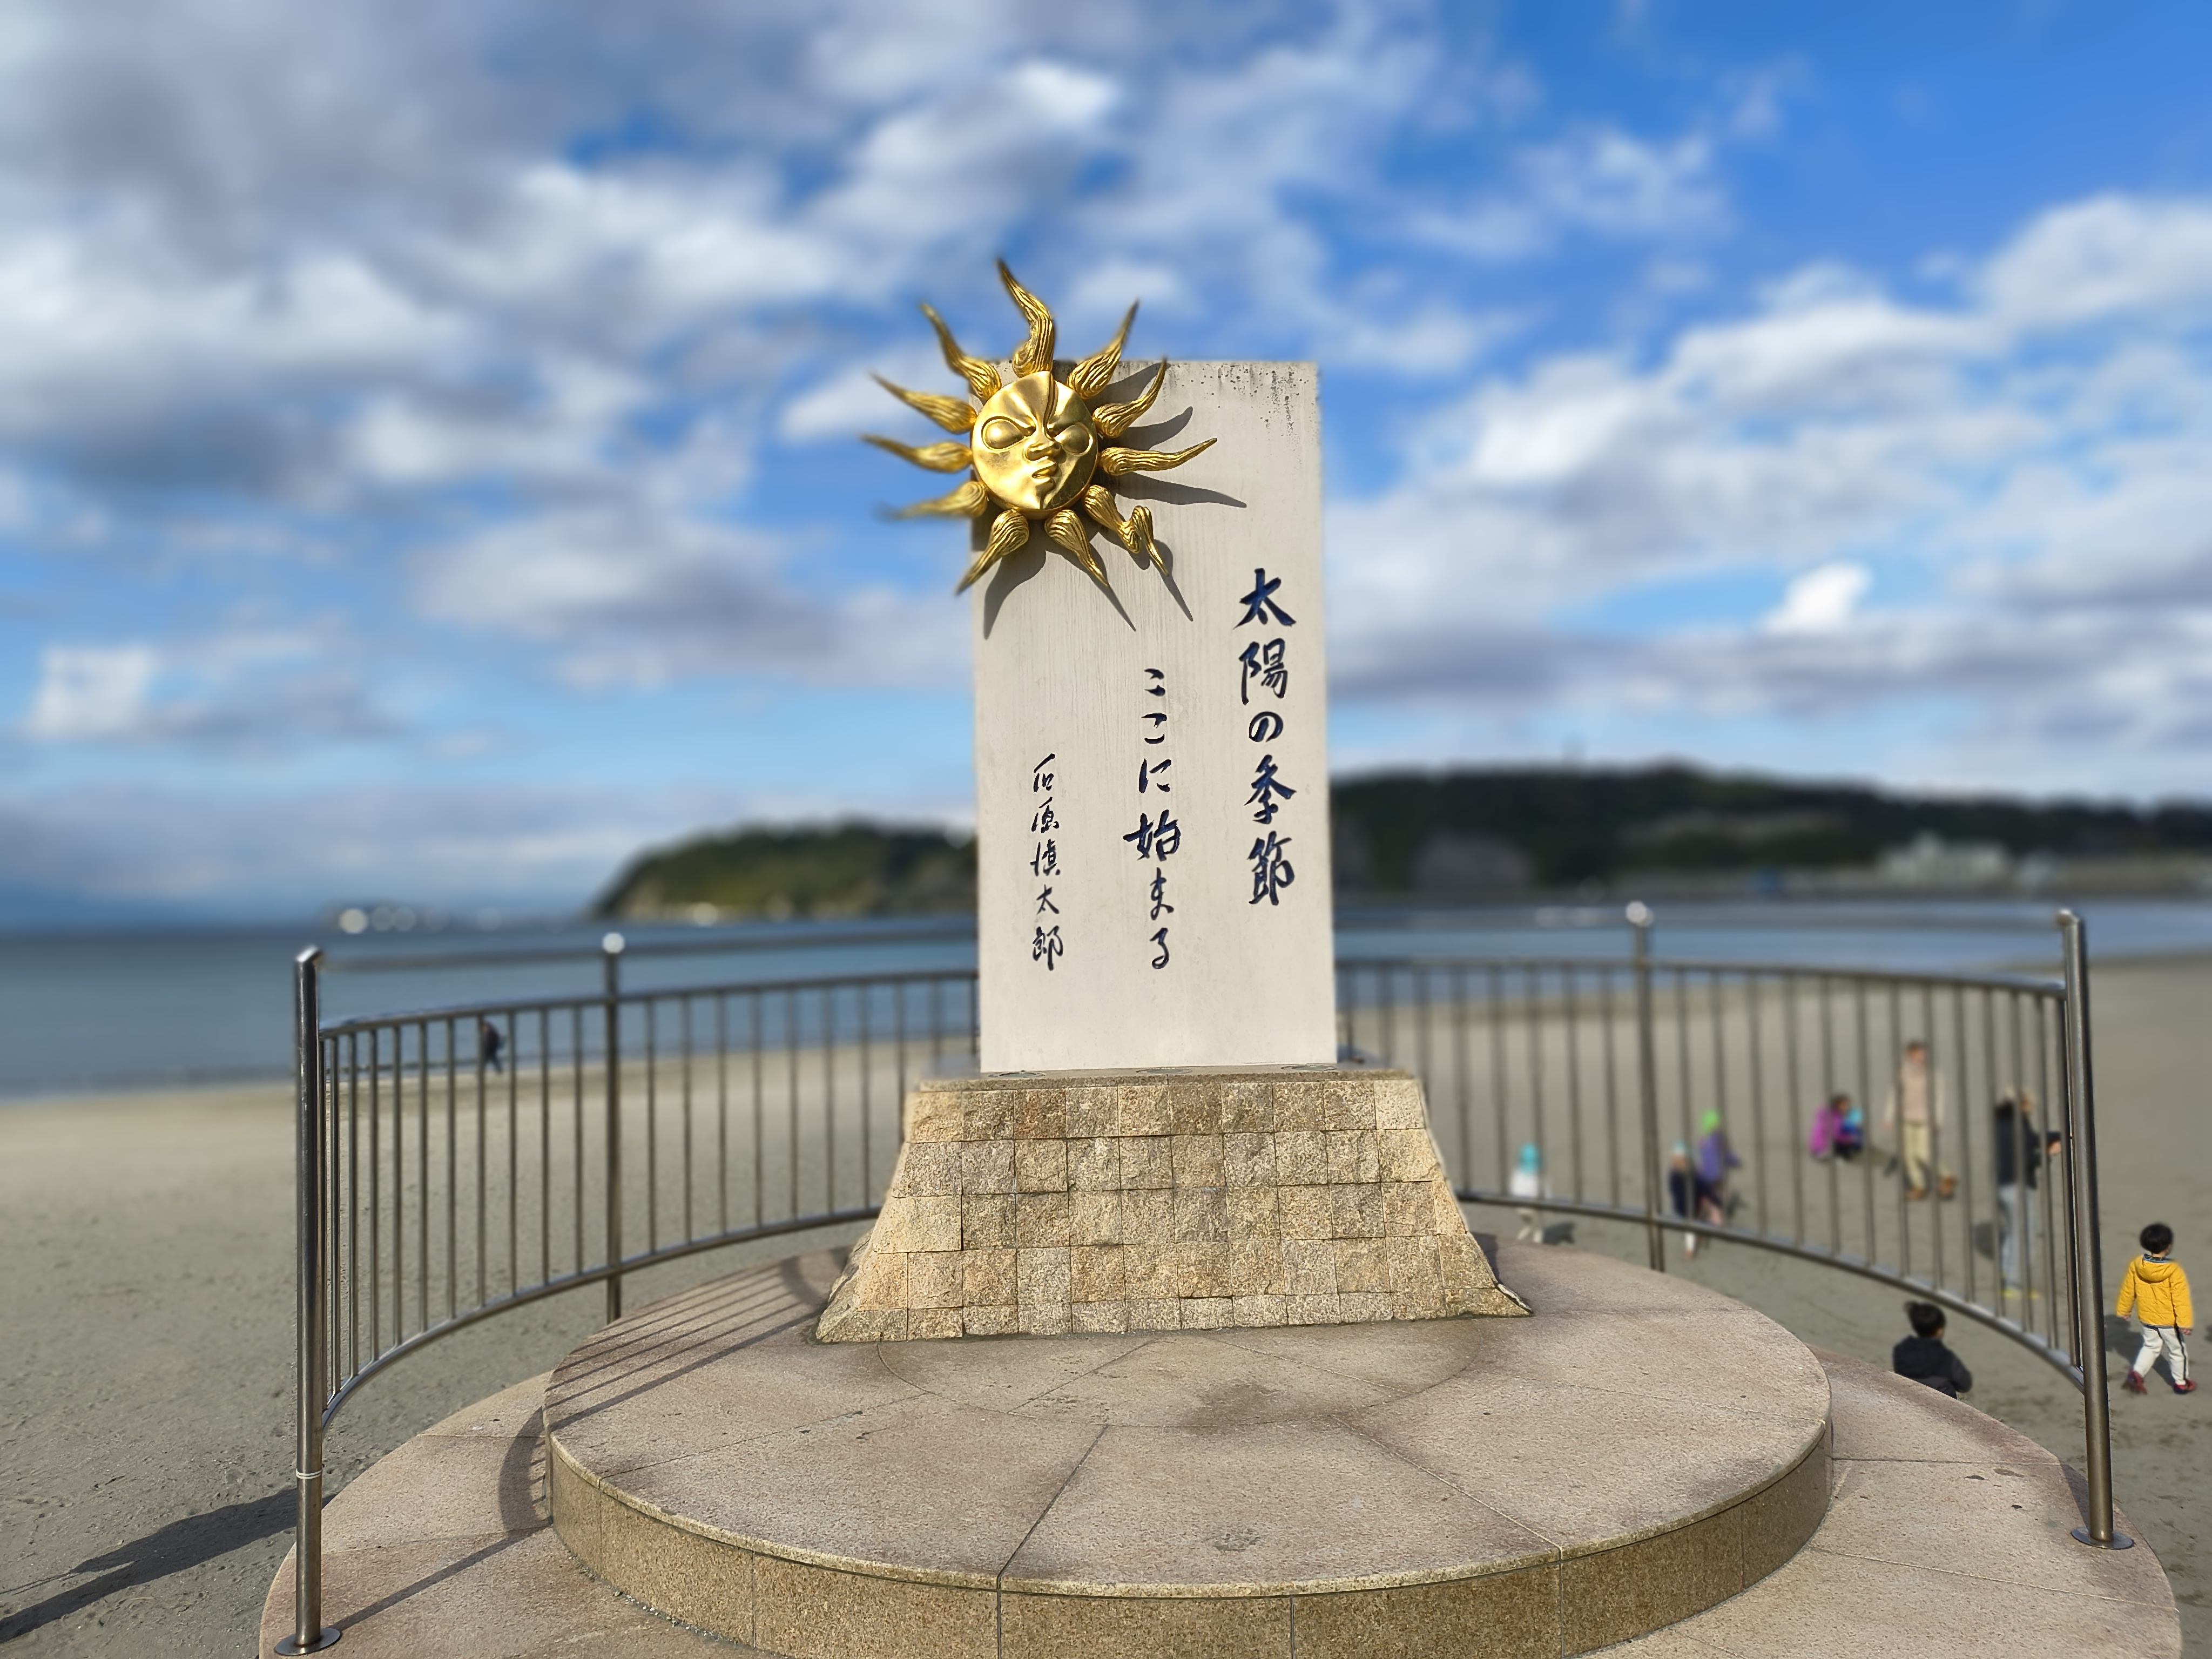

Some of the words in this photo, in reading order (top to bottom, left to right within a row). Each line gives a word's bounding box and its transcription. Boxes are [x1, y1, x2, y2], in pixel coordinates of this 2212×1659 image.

[1122, 668, 1182, 970] ここに始まる
[1233, 567, 1297, 906] 太陽の季節
